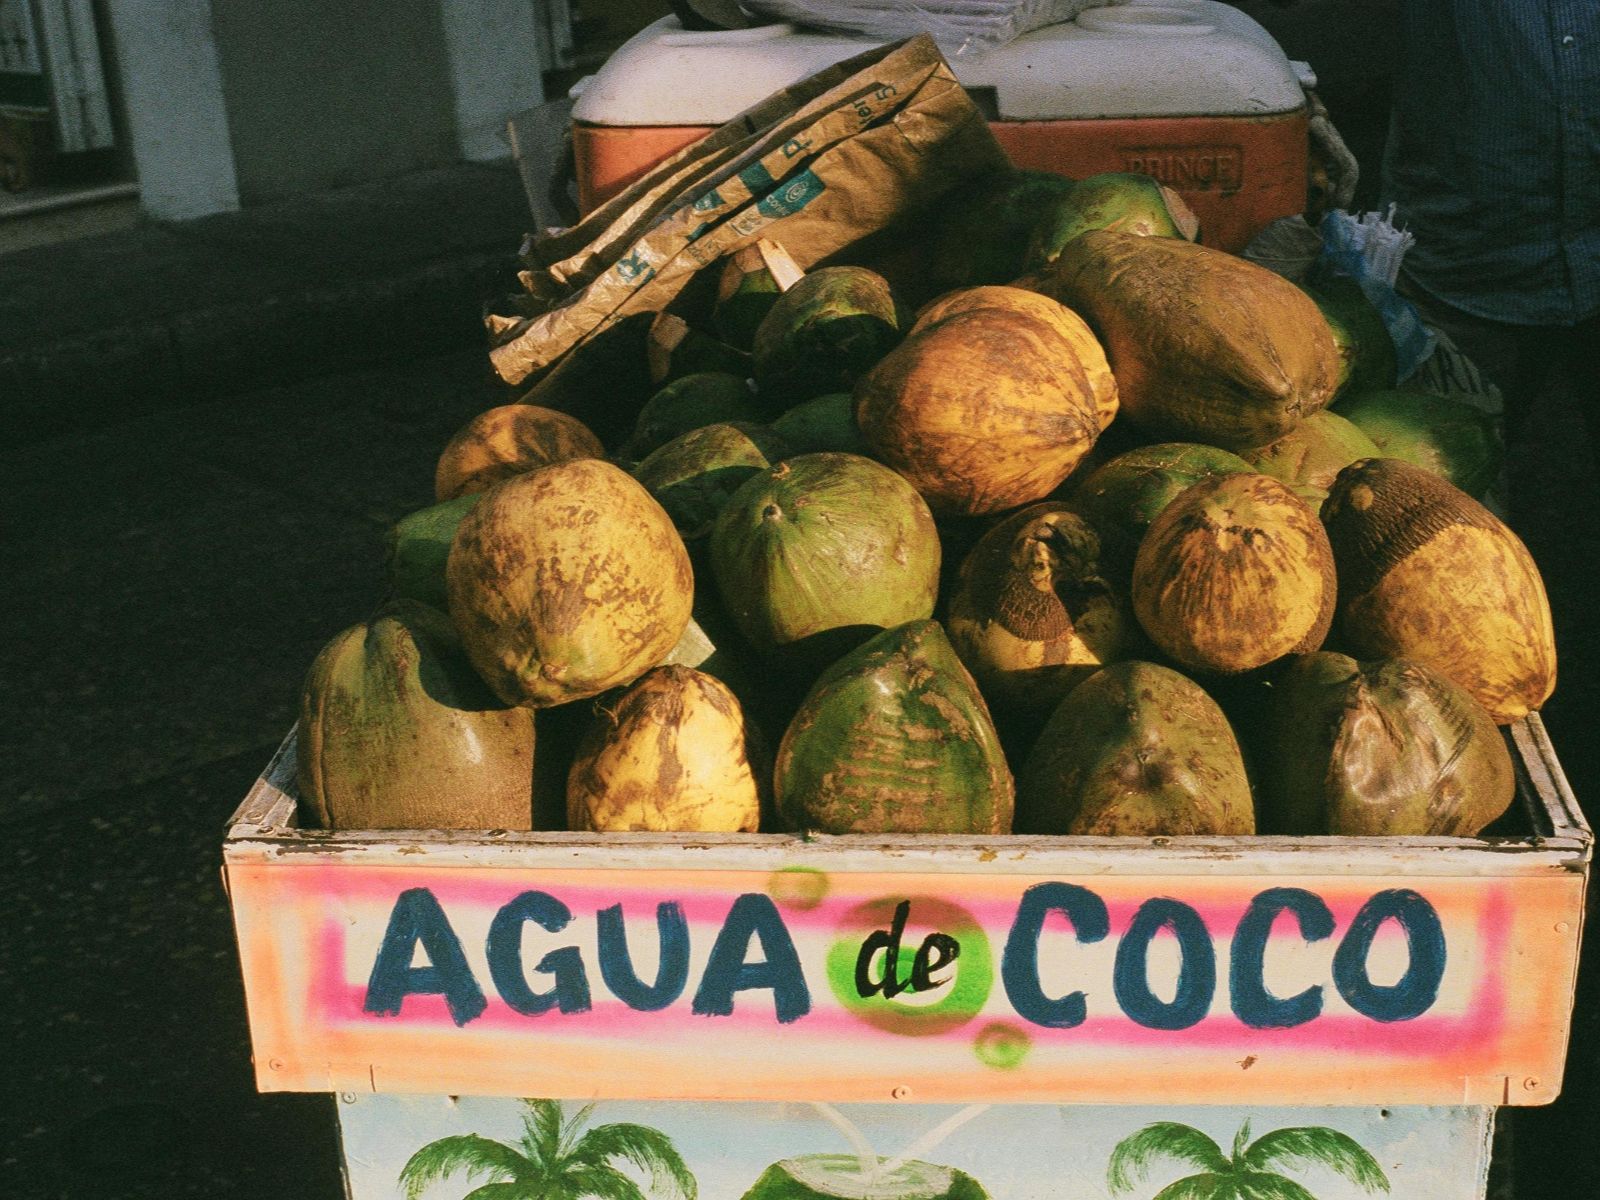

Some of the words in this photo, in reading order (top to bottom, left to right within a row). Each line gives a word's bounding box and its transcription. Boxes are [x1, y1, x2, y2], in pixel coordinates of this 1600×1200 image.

[1124, 153, 1234, 188] PRINCE
[363, 887, 812, 1028] AGUA
[855, 900, 960, 999] de
[1001, 881, 1448, 1031] COCO
